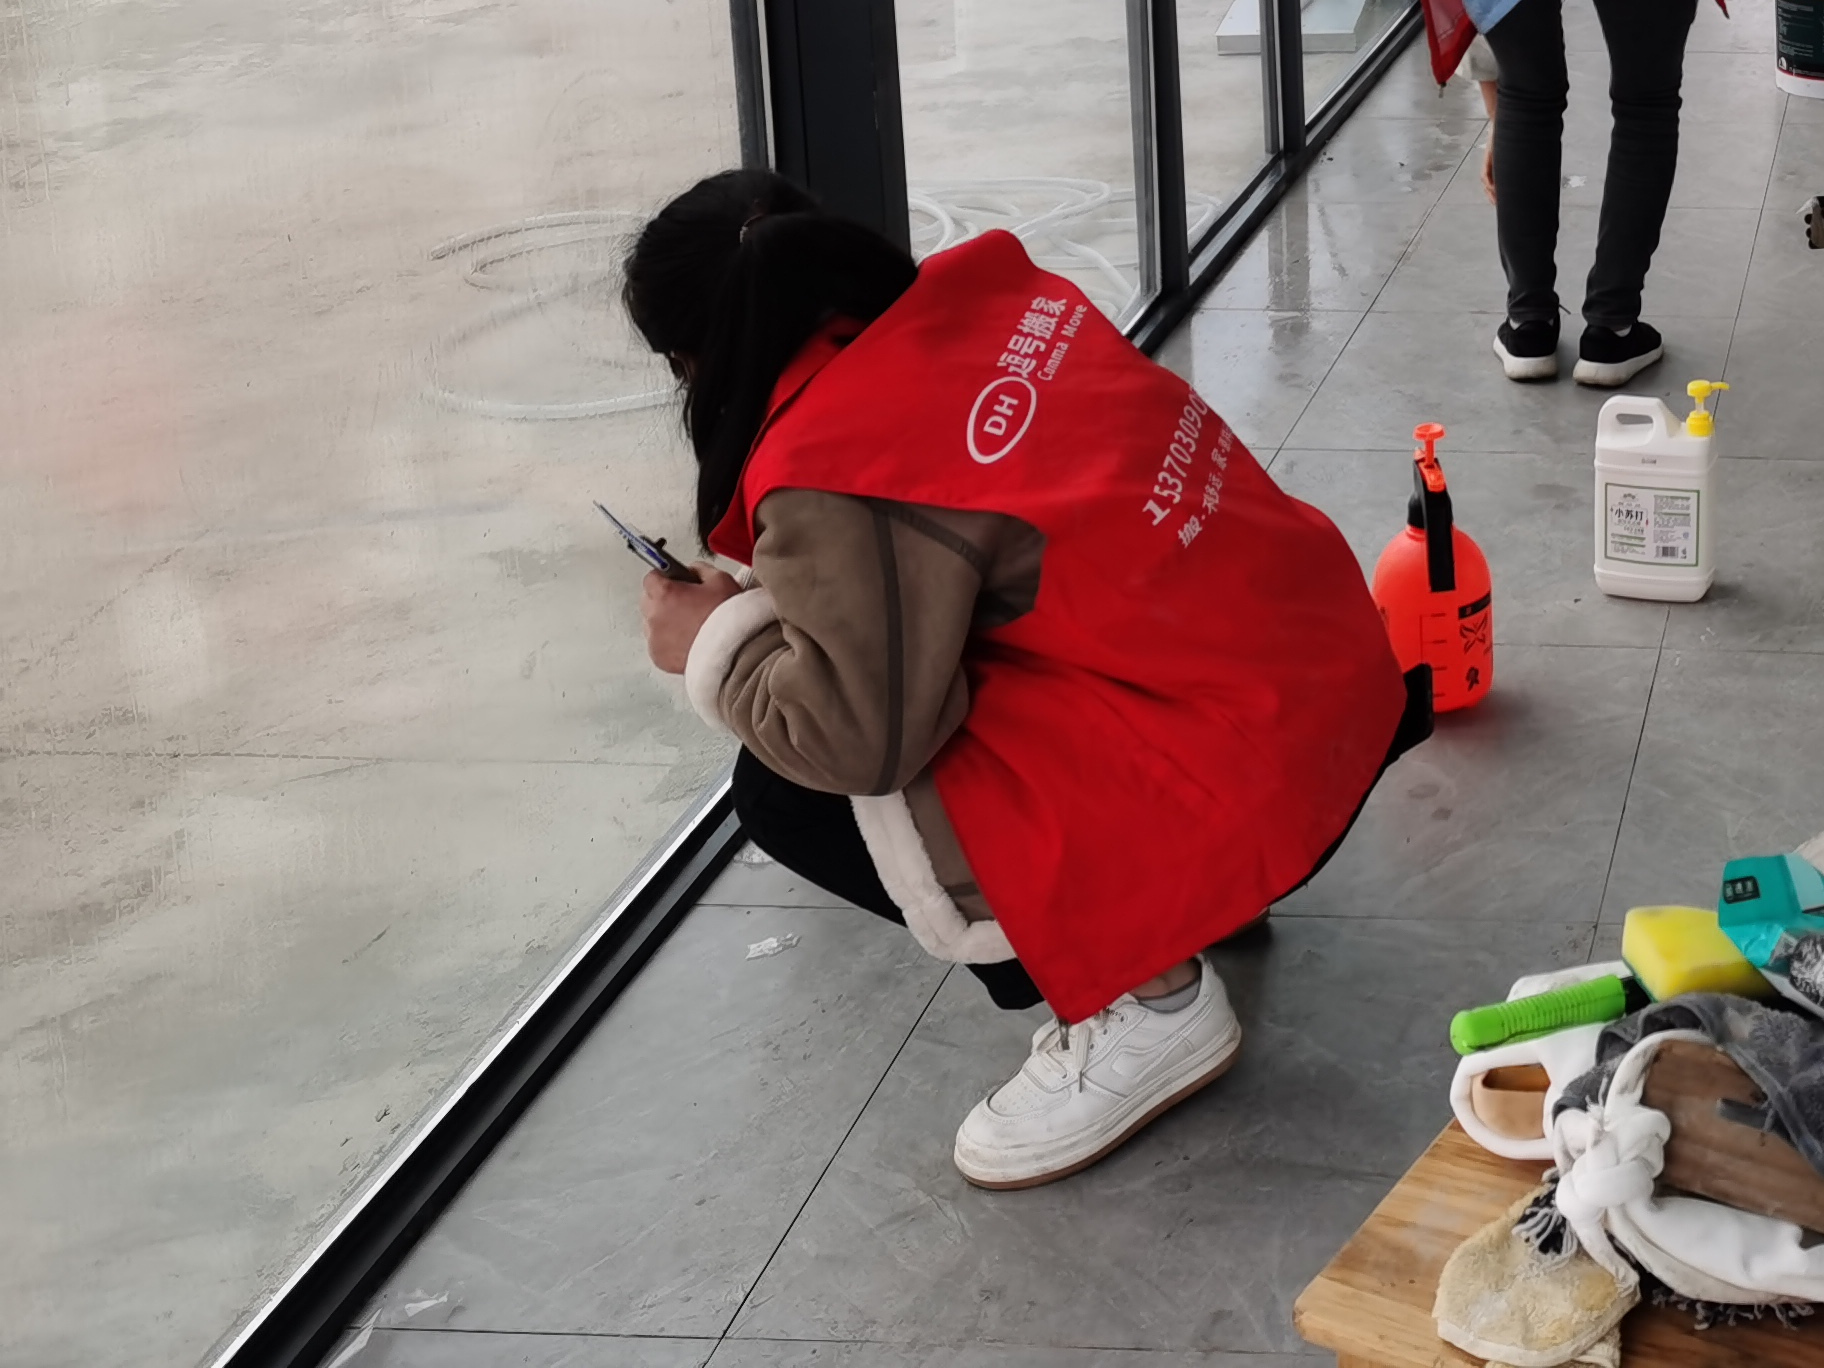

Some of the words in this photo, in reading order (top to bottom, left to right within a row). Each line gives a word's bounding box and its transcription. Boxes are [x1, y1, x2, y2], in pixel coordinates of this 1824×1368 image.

[997, 296, 1068, 379] 逗号搬家
[1037, 341, 1070, 381] Comma
[1061, 304, 1088, 338] Move
[983, 394, 1020, 436] DH
[1614, 507, 1644, 522] 小苏打
